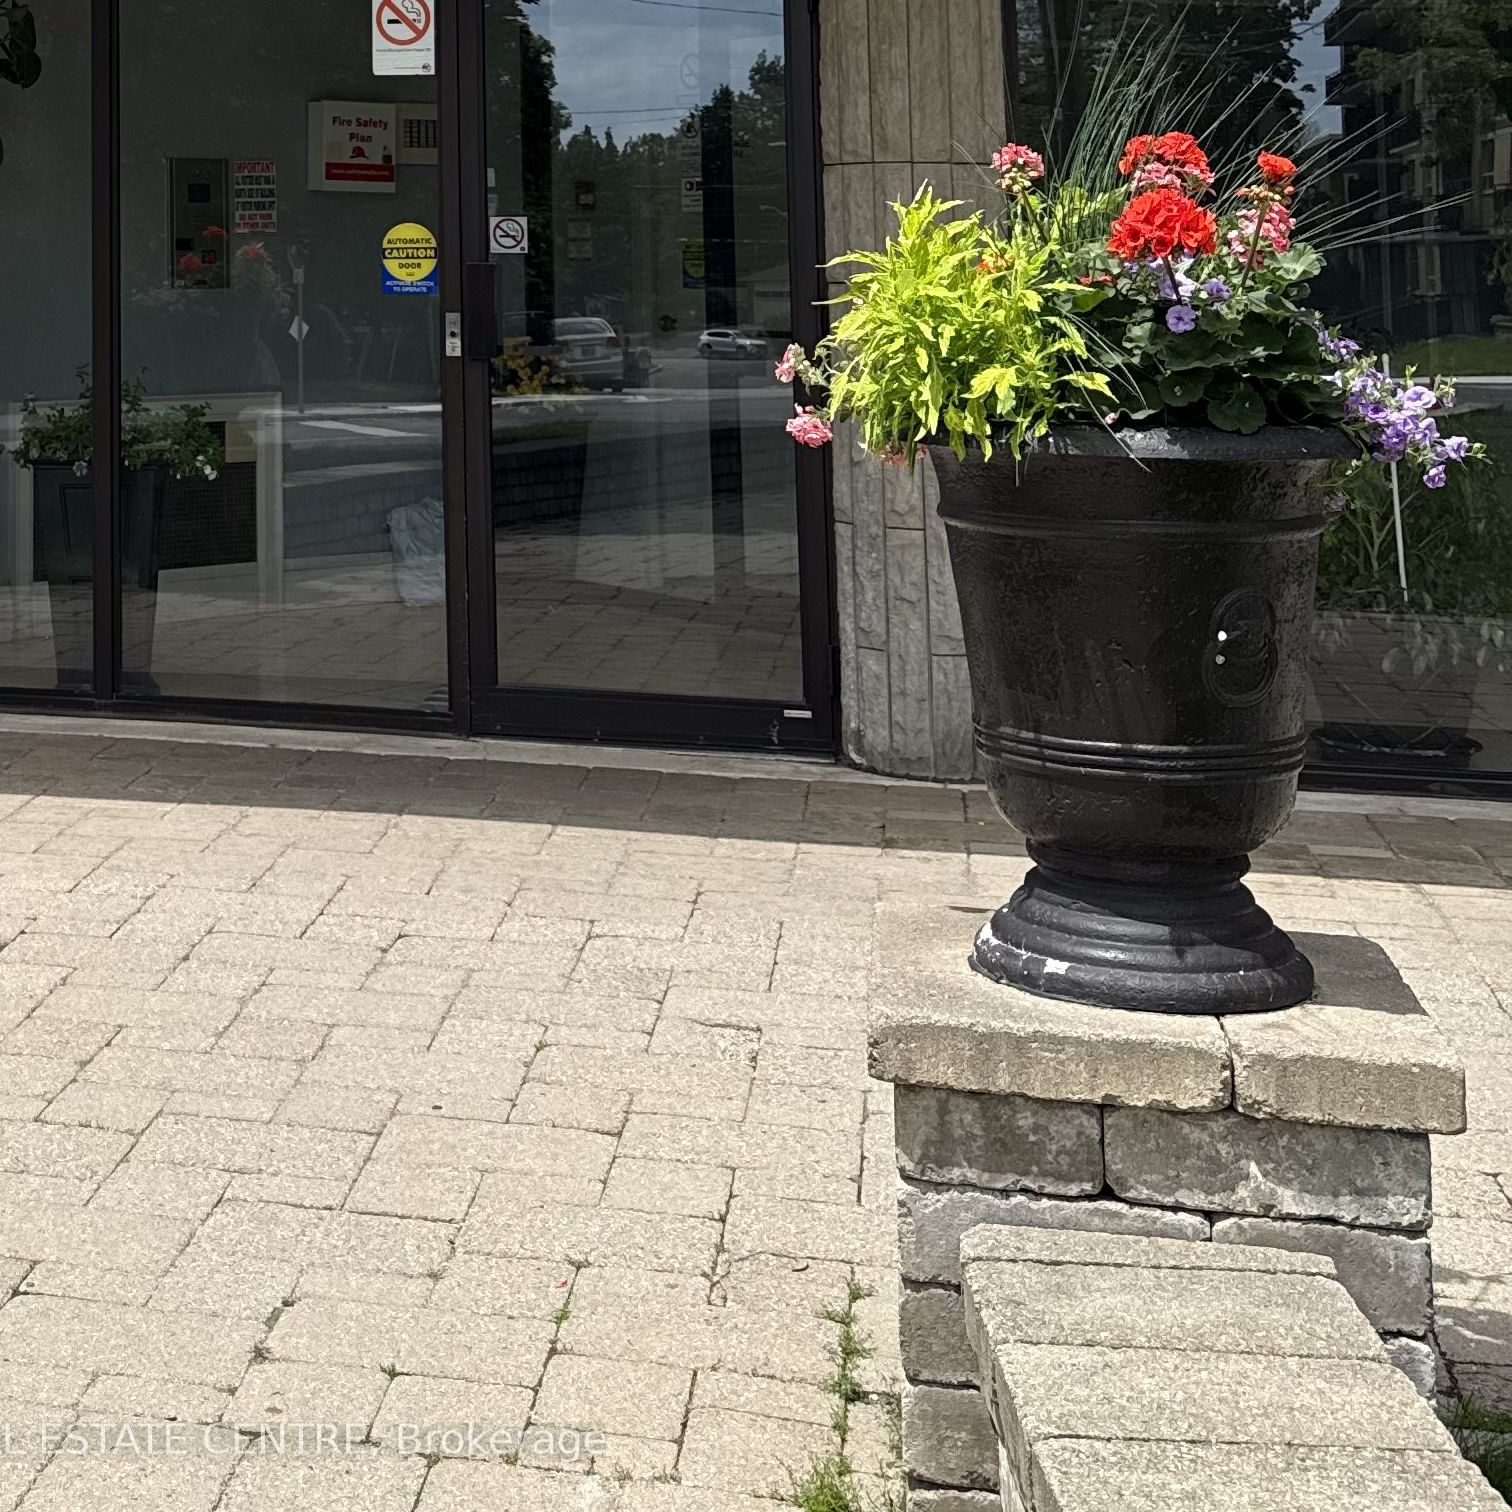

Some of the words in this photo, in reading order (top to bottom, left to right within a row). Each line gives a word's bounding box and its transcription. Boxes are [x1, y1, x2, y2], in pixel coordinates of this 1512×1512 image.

[332, 116, 353, 127] Fire
[355, 117, 389, 131] Safety
[349, 132, 373, 143] Plan
[387, 237, 433, 245] AUTOMATIC
[384, 248, 435, 258] CAUTION
[398, 262, 422, 270] DOOR
